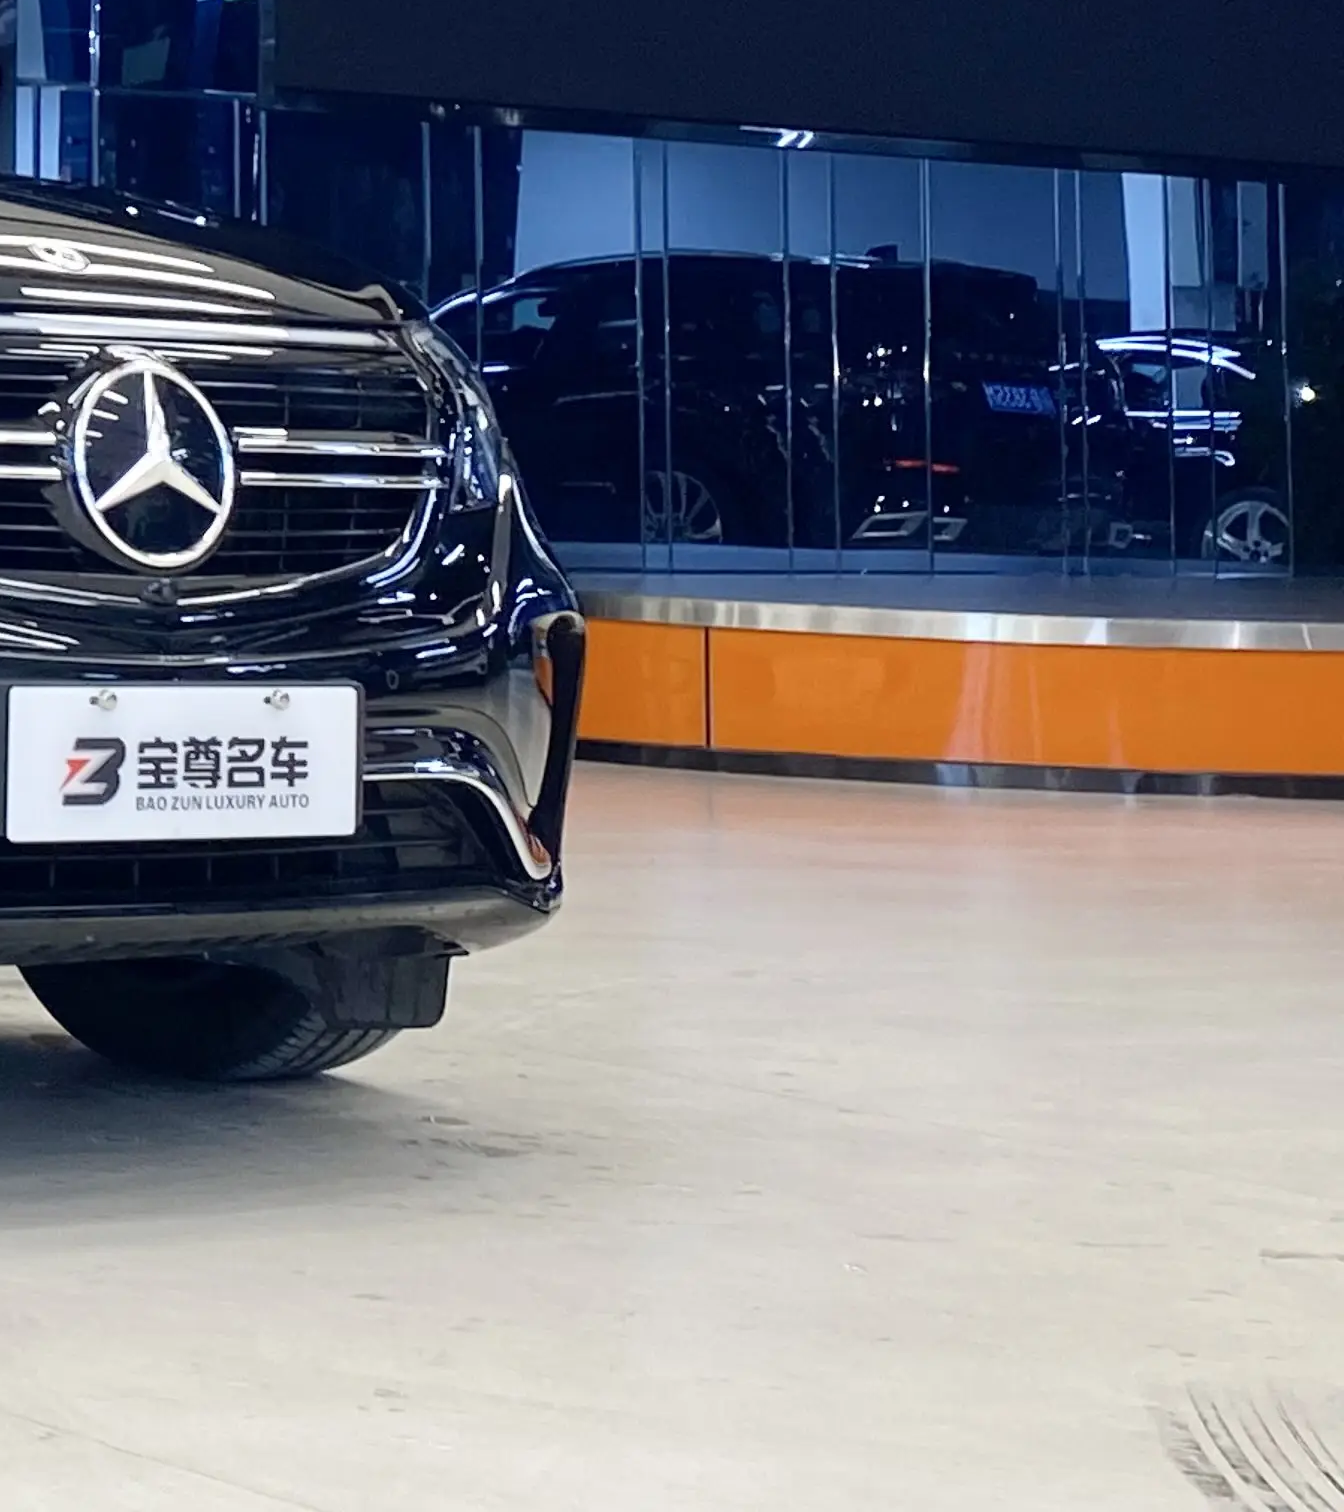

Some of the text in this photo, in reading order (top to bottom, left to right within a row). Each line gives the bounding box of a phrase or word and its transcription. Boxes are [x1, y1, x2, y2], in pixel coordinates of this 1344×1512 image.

[136, 735, 309, 789] 宝尊名车
[135, 793, 310, 811] BAO ZUN LUXURY AUTO
